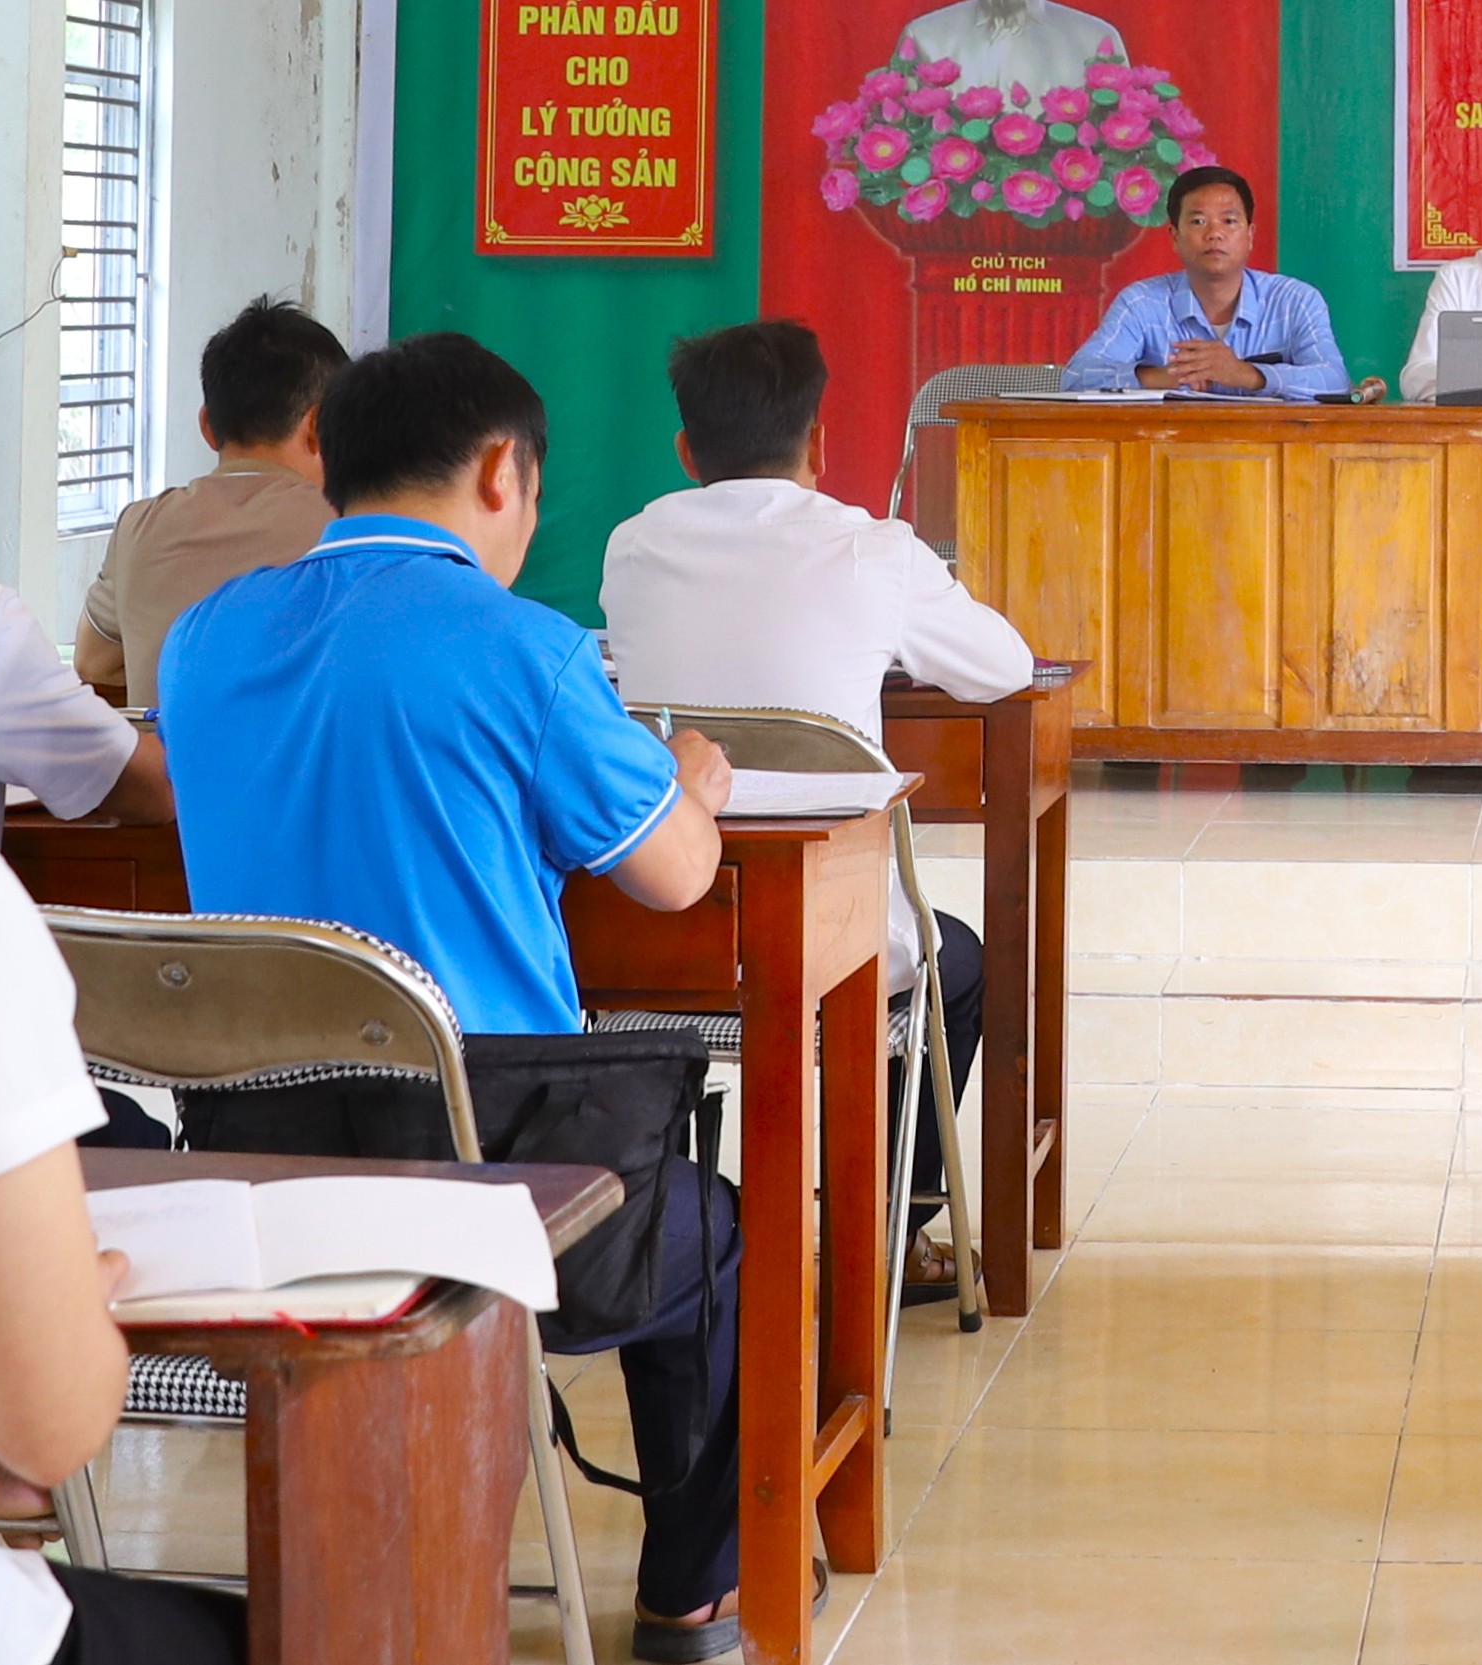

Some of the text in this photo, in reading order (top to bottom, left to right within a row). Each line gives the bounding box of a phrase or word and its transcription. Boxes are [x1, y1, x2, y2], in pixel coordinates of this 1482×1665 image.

[566, 56, 628, 86] CHO
[522, 97, 670, 137] LÝ TƯỞNG
[515, 148, 676, 192] CỘNG SẢN
[971, 252, 1045, 271] CHỦ TỊCH
[954, 273, 1061, 292] HỒ CHÍ MINH
